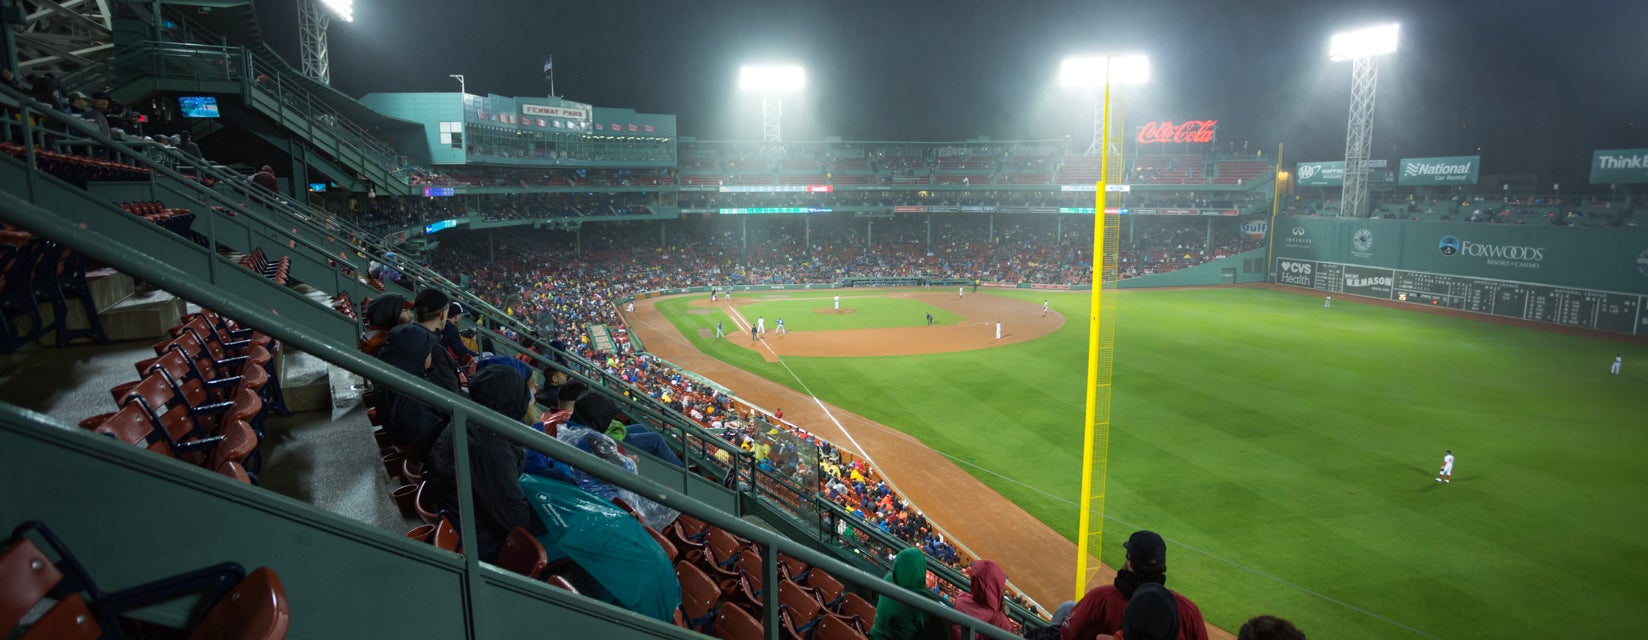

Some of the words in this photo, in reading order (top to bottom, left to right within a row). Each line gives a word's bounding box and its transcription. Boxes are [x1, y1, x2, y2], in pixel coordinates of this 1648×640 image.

[526, 106, 559, 115] FENWAY
[1138, 120, 1217, 144] Coca-Cola
[1418, 162, 1470, 174] National
[1241, 222, 1266, 232] Gulf
[1291, 262, 1312, 274] CVS
[1281, 272, 1310, 285] Health
